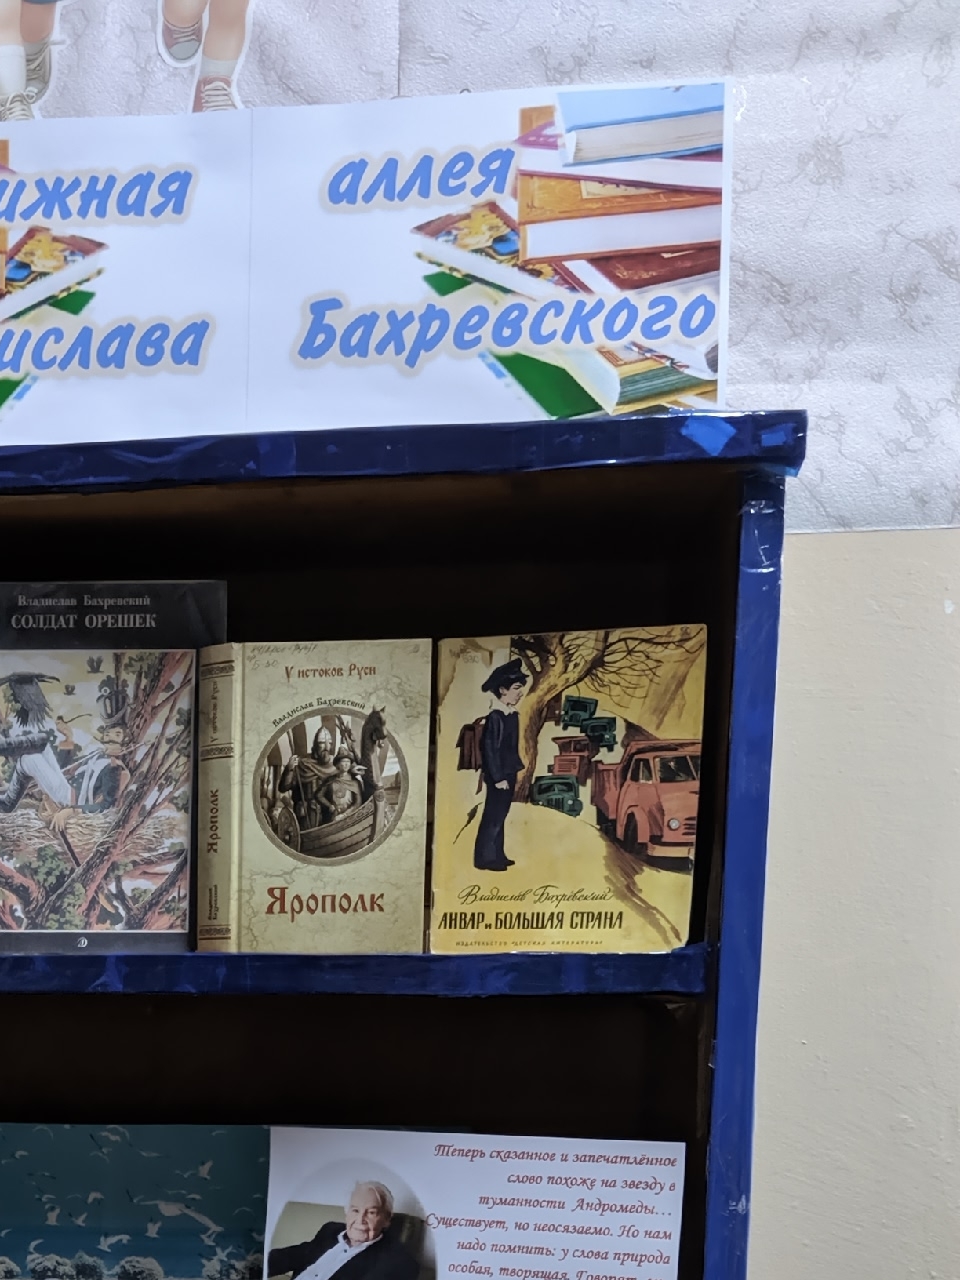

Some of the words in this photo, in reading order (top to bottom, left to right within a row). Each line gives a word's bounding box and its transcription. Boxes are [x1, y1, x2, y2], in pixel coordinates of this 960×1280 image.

[327, 147, 515, 205] аллея
[297, 294, 716, 367] Бахревского
[17, 595, 77, 606] Владислав
[83, 595, 151, 609] Бахревский
[11, 614, 77, 630] СОЛДАТ
[84, 614, 156, 628] ОРЕШЕК
[284, 666, 294, 681] У
[297, 666, 344, 679] истоков
[348, 663, 376, 680] Руси
[272, 700, 314, 727] Владислав
[316, 697, 366, 710] Бахревский
[207, 789, 222, 854] Ярополк
[265, 886, 385, 923] Ярополк
[457, 884, 533, 905] Владислав
[533, 884, 615, 909] Бахревский
[438, 912, 485, 930] АНВАР
[485, 922, 492, 930] и
[495, 912, 565, 930] БОЛЬШАЯ
[570, 911, 624, 930] СТРАНА
[434, 1144, 485, 1162] Теперь
[489, 1149, 556, 1162] сказанное
[560, 1153, 569, 1163] и
[572, 1152, 677, 1167] запечатлённое
[507, 1172, 542, 1185] слово
[546, 1175, 597, 1190] похоже
[600, 1178, 617, 1188] на
[621, 1176, 665, 1195] звезду
[669, 1181, 676, 1191] в
[478, 1194, 566, 1208] туманности
[425, 1212, 508, 1232] Существует,
[514, 1219, 529, 1231] но
[533, 1221, 613, 1236] неосязаемо.
[617, 1225, 639, 1239] Но
[644, 1228, 672, 1240] нам
[456, 1238, 486, 1251] надо
[490, 1242, 555, 1256] помнить:
[560, 1247, 569, 1261] у
[572, 1247, 609, 1260] слова
[612, 1250, 670, 1266] природа
[448, 1261, 494, 1277] особая,
